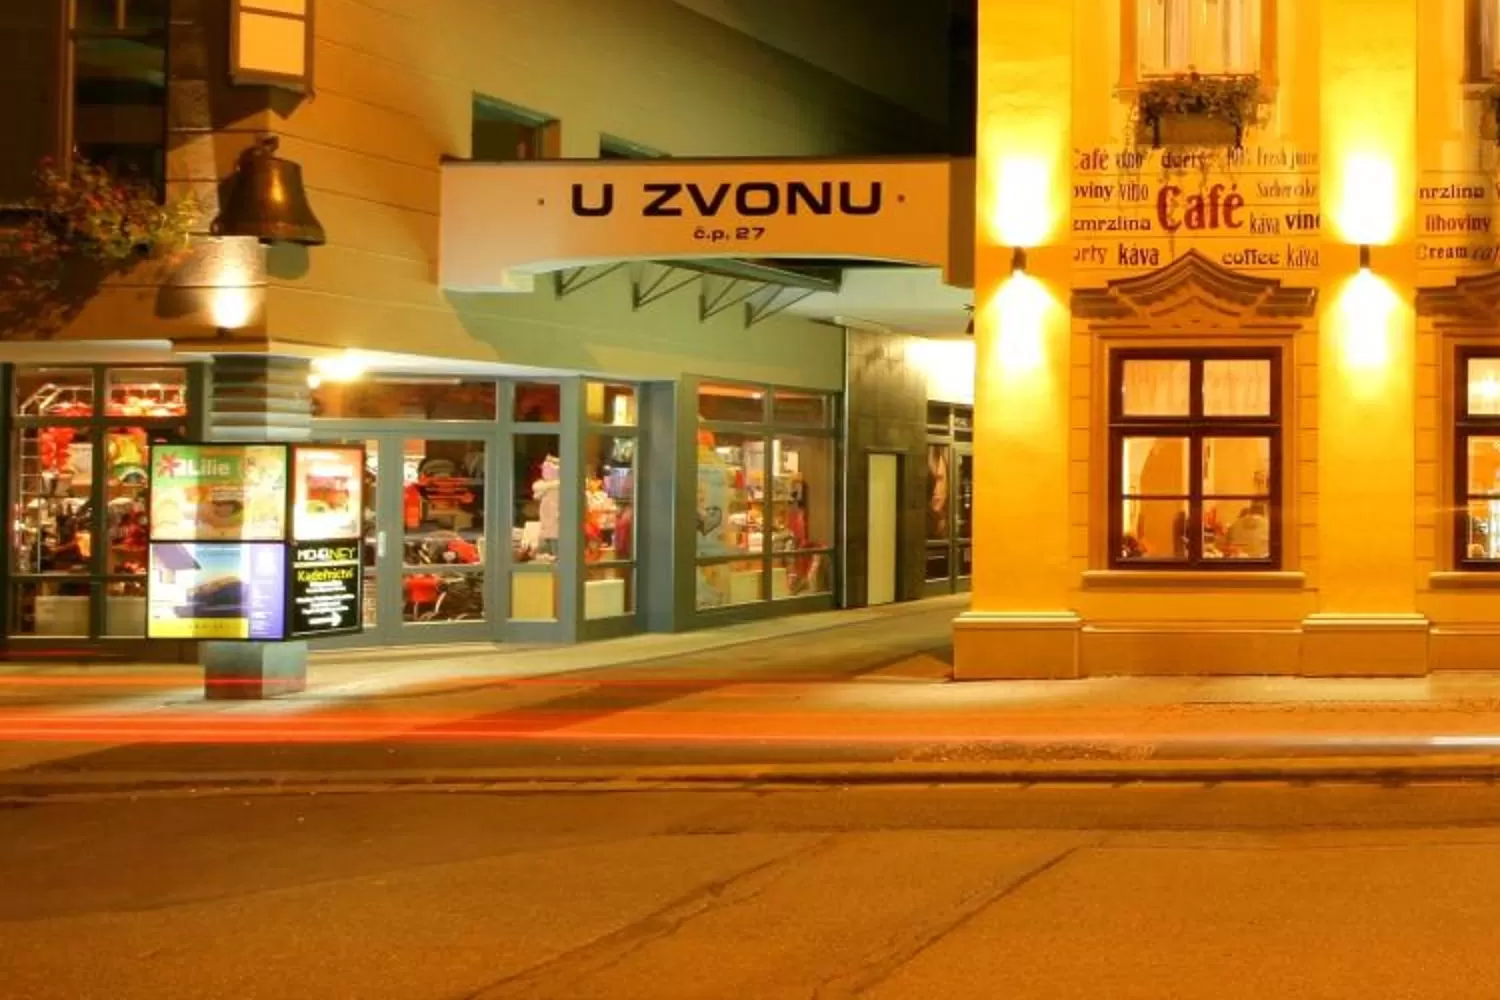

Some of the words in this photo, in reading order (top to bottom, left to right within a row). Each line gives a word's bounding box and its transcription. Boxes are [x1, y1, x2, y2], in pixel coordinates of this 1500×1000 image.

[571, 184, 613, 217] U
[642, 182, 882, 216] ZVONU
[1157, 183, 1244, 233] Café
[736, 227, 765, 240] 27
